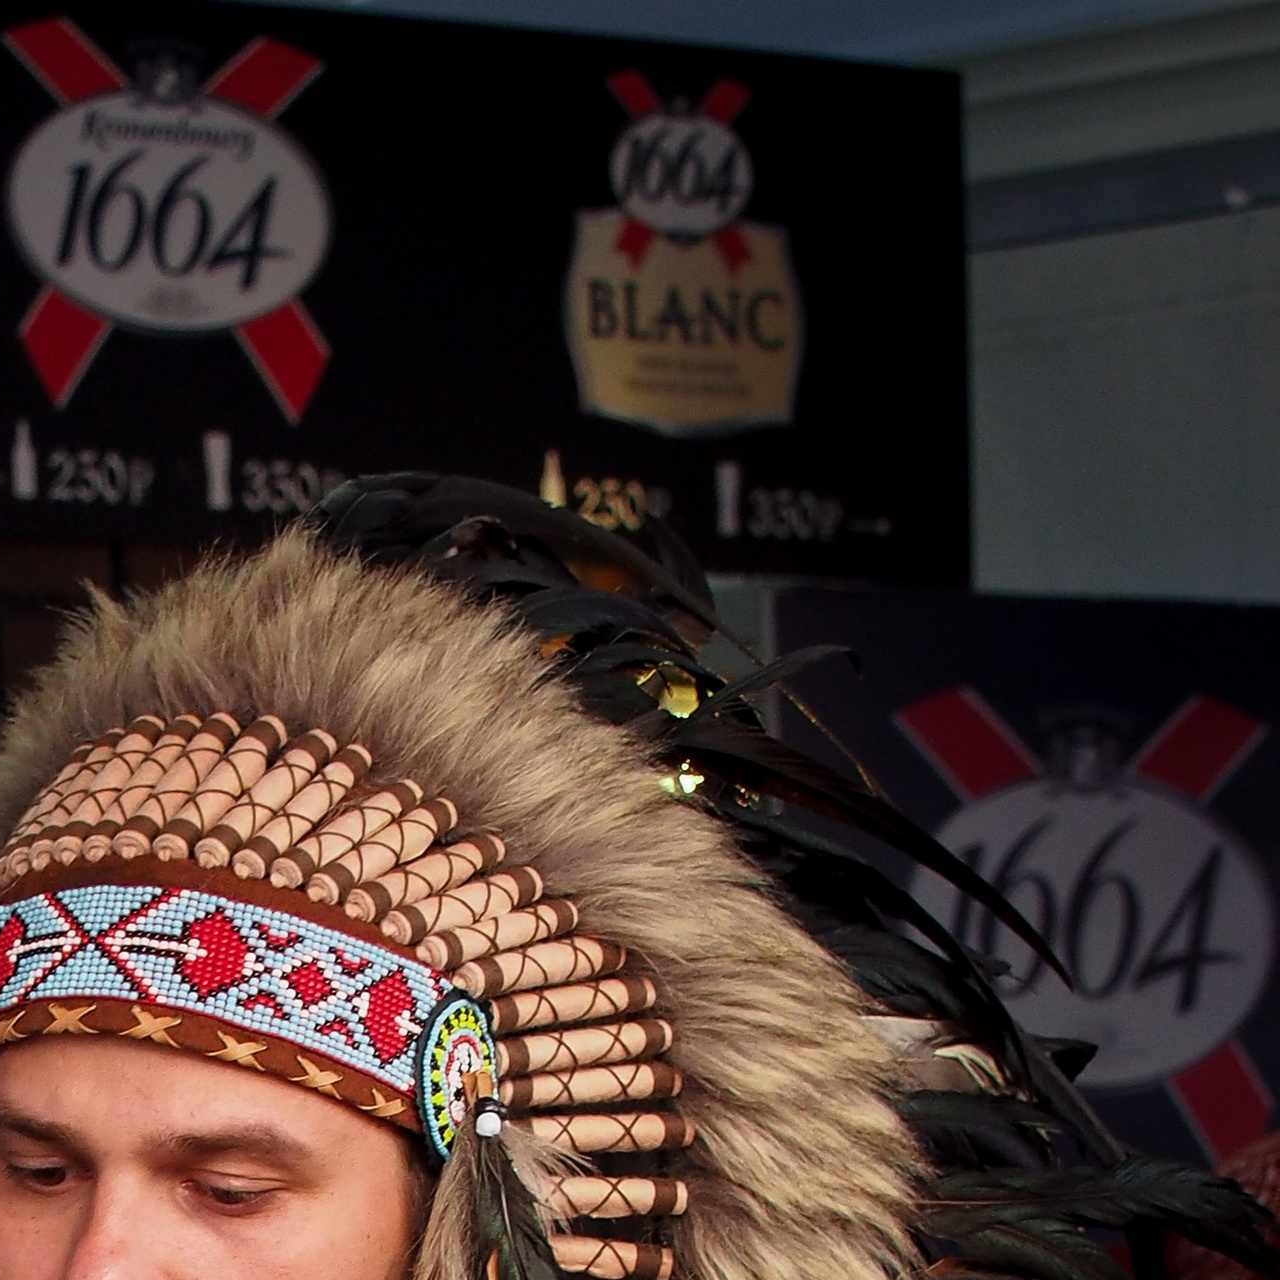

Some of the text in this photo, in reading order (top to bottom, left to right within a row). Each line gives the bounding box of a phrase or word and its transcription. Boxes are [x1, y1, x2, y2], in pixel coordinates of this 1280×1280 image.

[57, 149, 293, 292] 1664
[622, 126, 740, 210] 1664
[588, 279, 786, 350] BLANC
[950, 813, 1246, 1014] 1664
